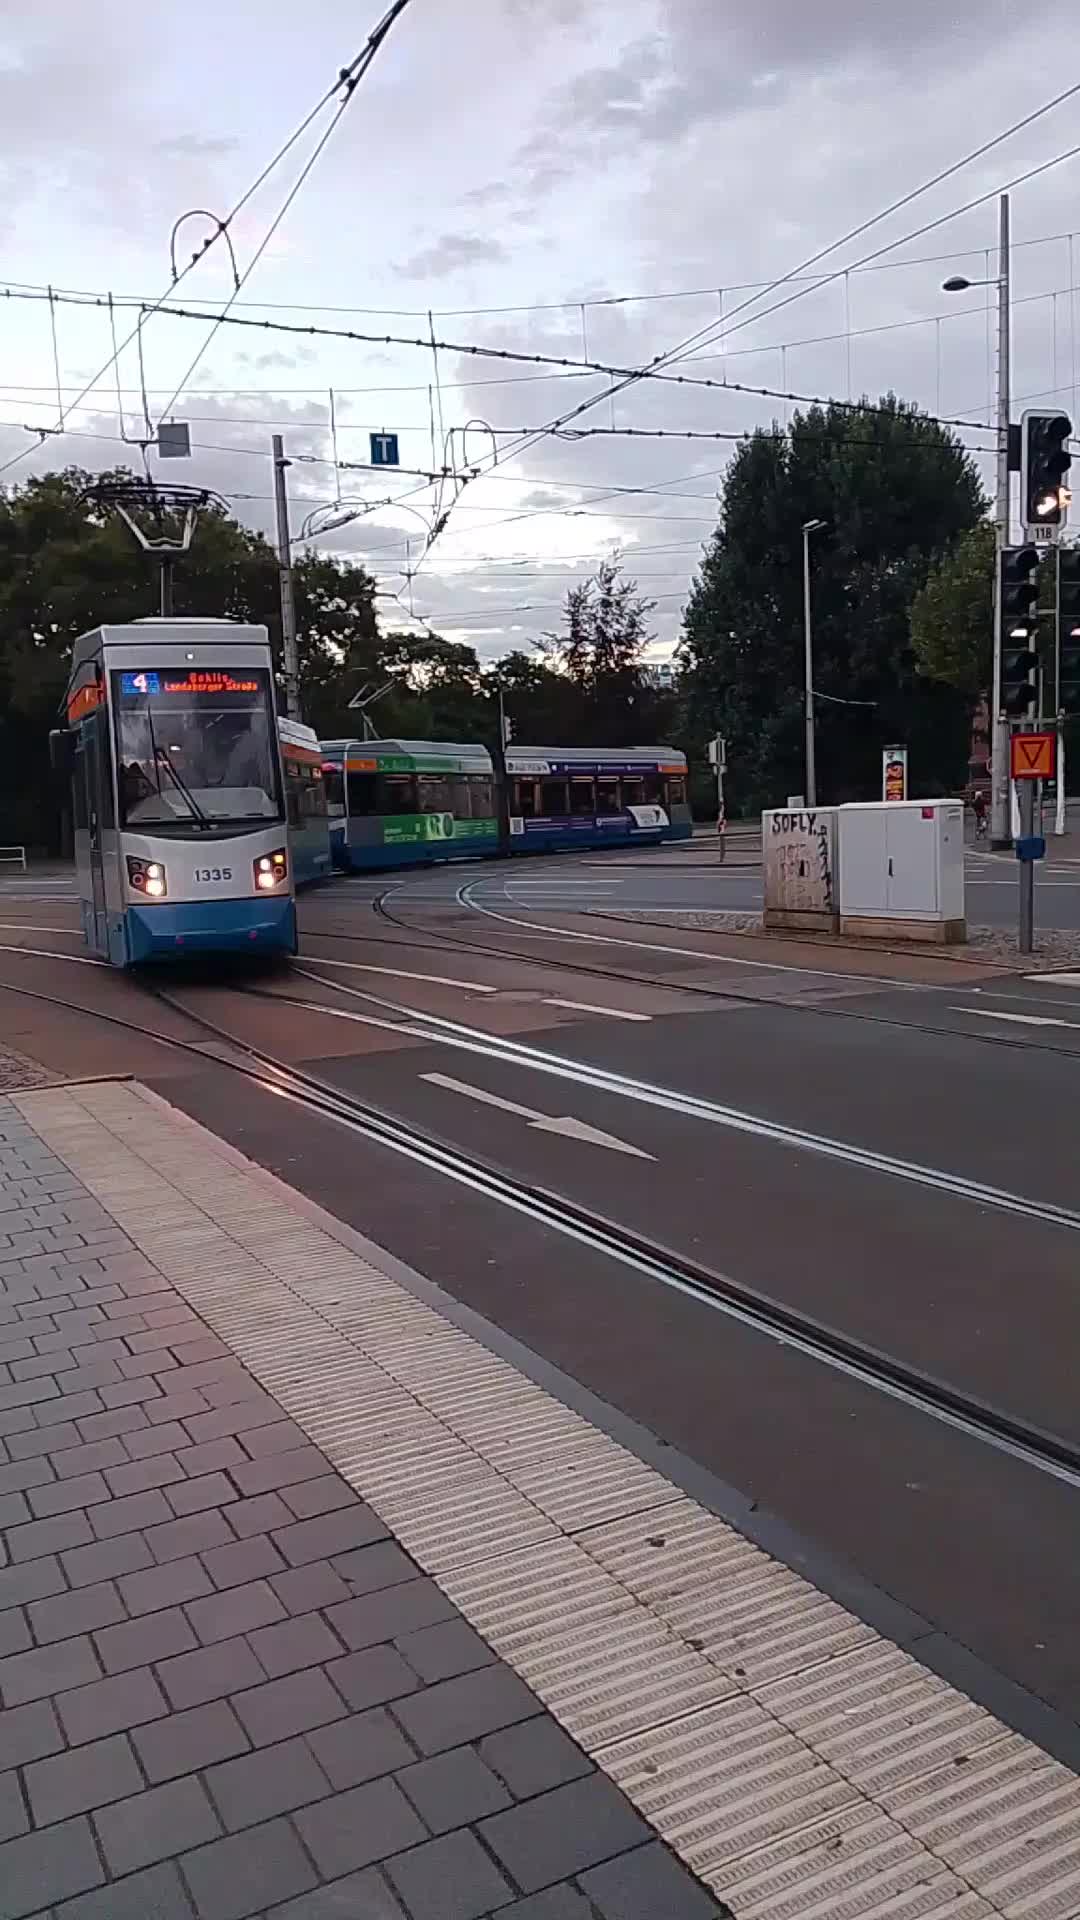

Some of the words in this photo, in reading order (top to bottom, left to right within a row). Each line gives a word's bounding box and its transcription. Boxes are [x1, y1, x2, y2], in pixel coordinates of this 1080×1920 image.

[375, 436, 393, 462] T
[132, 674, 147, 693] 4
[195, 867, 232, 882] 1335
